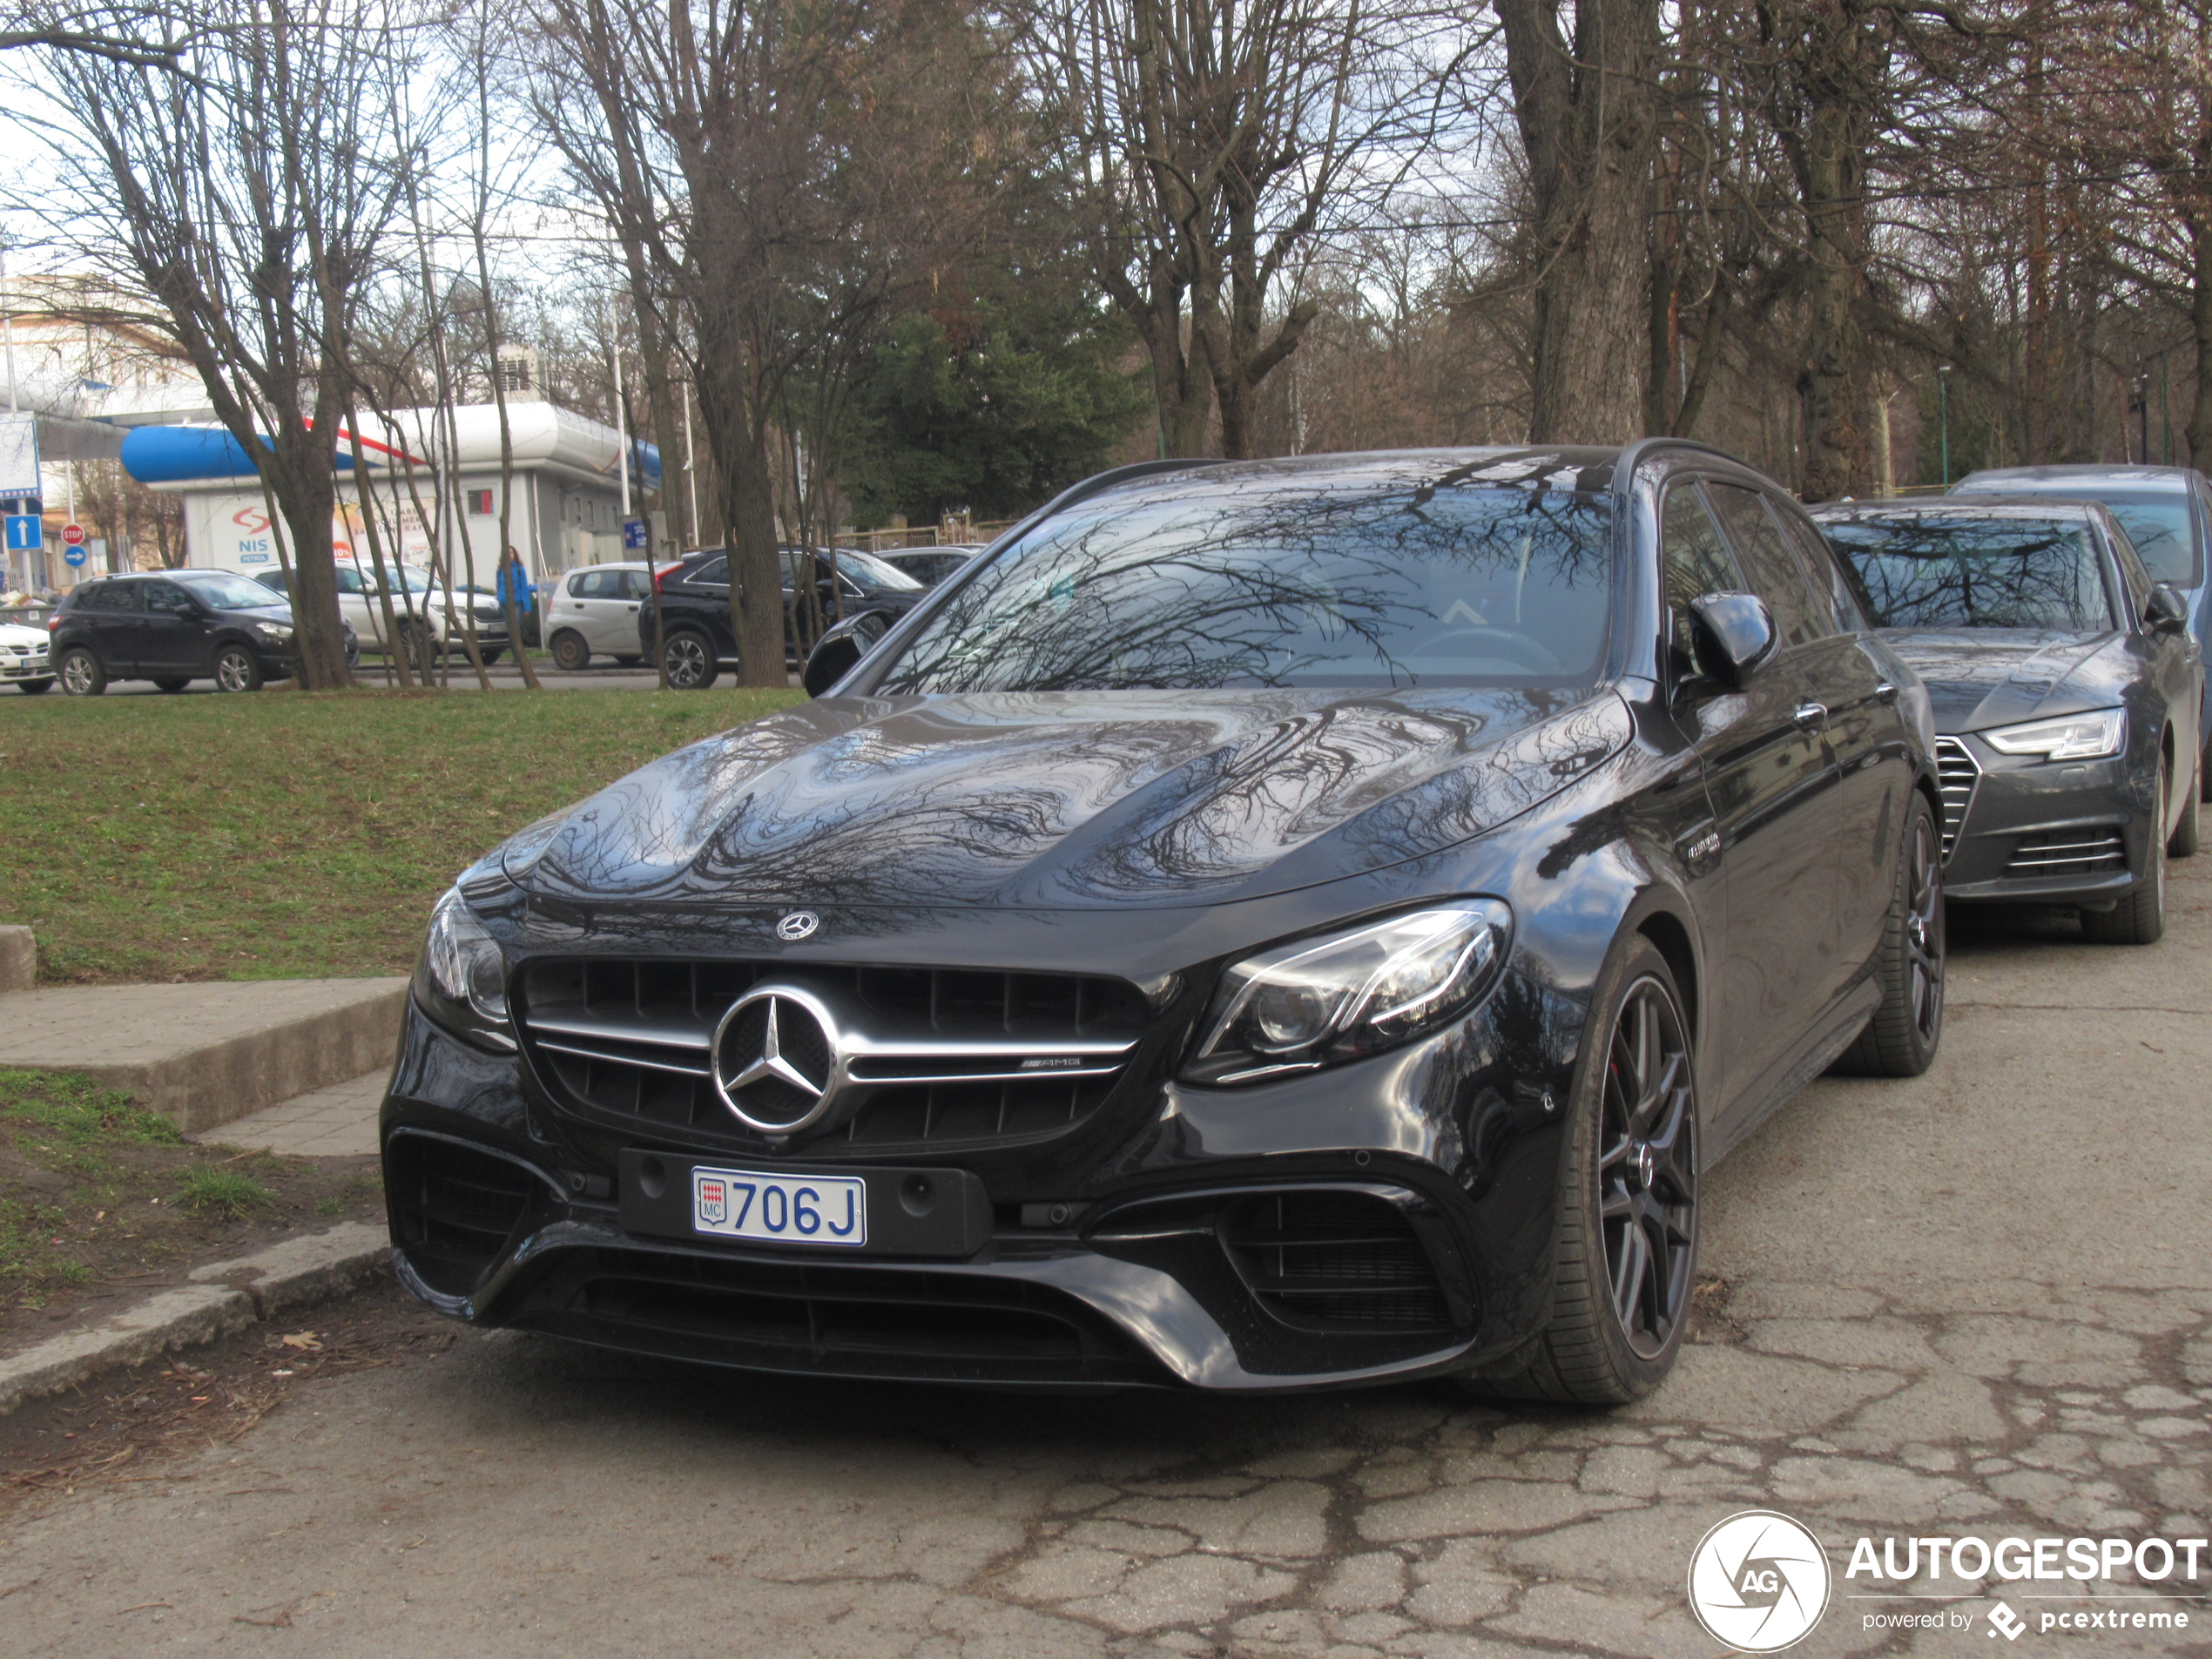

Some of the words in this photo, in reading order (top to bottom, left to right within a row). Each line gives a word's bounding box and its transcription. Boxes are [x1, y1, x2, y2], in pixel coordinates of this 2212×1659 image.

[64, 529, 82, 539] STOP
[239, 539, 268, 552] NIS
[704, 1202, 722, 1217] MC
[732, 1182, 855, 1236] 706J
